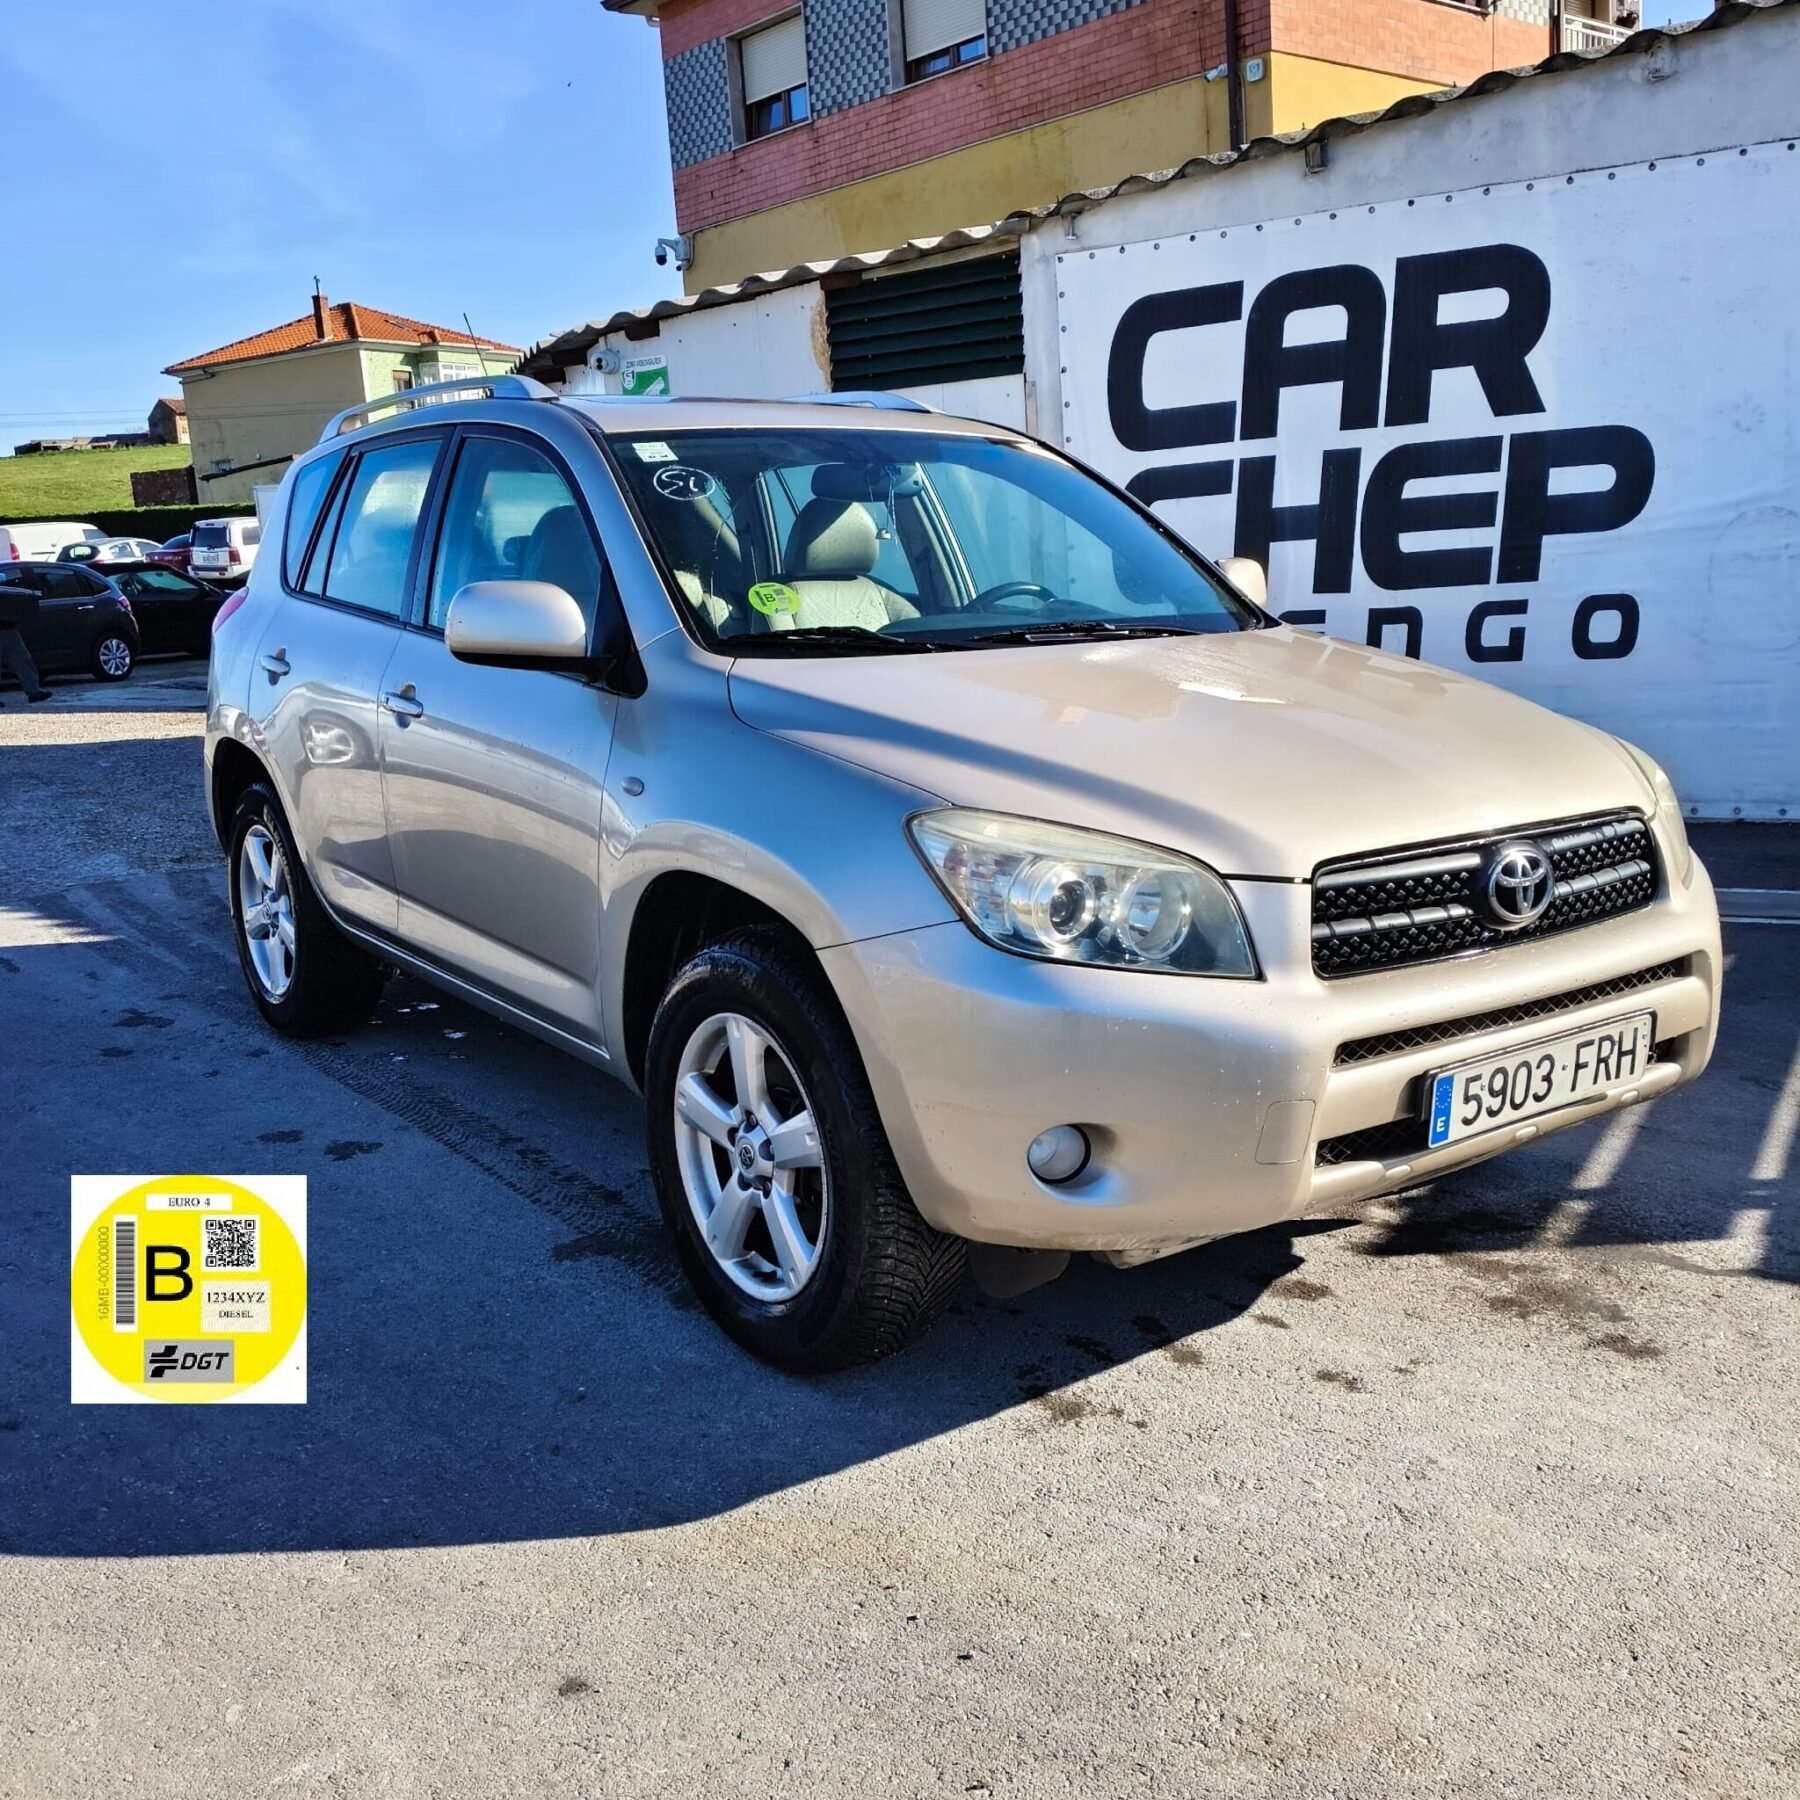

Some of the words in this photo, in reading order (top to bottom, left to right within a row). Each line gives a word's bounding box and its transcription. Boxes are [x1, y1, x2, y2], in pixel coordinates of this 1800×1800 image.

[1107, 243, 1551, 452] CAR
[763, 594, 776, 603] B
[1461, 1053, 1556, 1127] 5903
[1570, 1027, 1639, 1093] FRH
[1436, 1116, 1445, 1133] E
